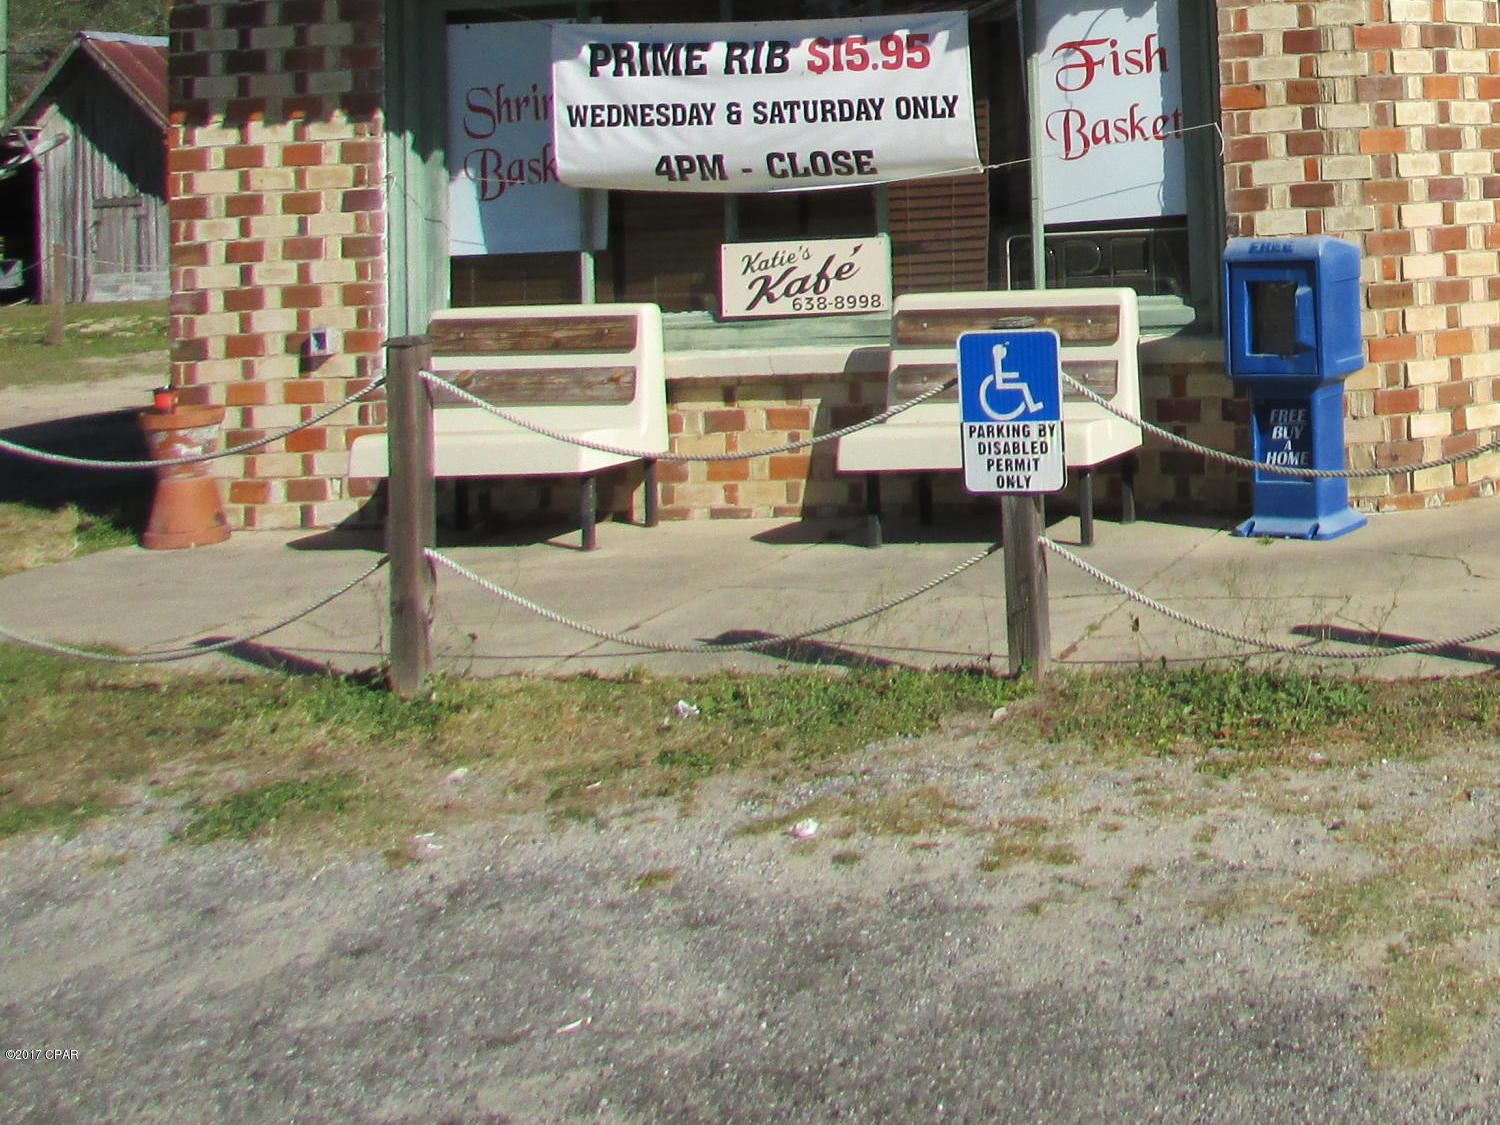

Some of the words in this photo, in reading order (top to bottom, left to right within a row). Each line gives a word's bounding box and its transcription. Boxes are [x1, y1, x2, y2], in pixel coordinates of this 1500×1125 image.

[588, 41, 711, 77] PRIME
[723, 40, 791, 75] RIB
[806, 33, 931, 74] $15.95
[1052, 32, 1169, 92] Fish
[566, 101, 717, 127] WEDNESDAY
[726, 102, 742, 125] &
[753, 97, 885, 124] SATURDAY
[895, 95, 959, 120] ONLY
[1045, 102, 1184, 161] Basket
[655, 153, 730, 182] 4PM
[766, 150, 879, 179] CLOSE
[741, 245, 813, 276] Katie's
[745, 243, 863, 312] Kafé
[792, 294, 882, 311] 638-8998
[1270, 409, 1307, 424] FREE
[969, 424, 1031, 438] PARKING
[1038, 423, 1056, 438] BY
[1271, 426, 1303, 440] BUY
[978, 441, 1048, 455] DISABLED
[1283, 441, 1292, 452] A
[987, 458, 1040, 472] PERMIT
[1265, 451, 1309, 466] HOME
[996, 475, 1031, 489] ONLY
